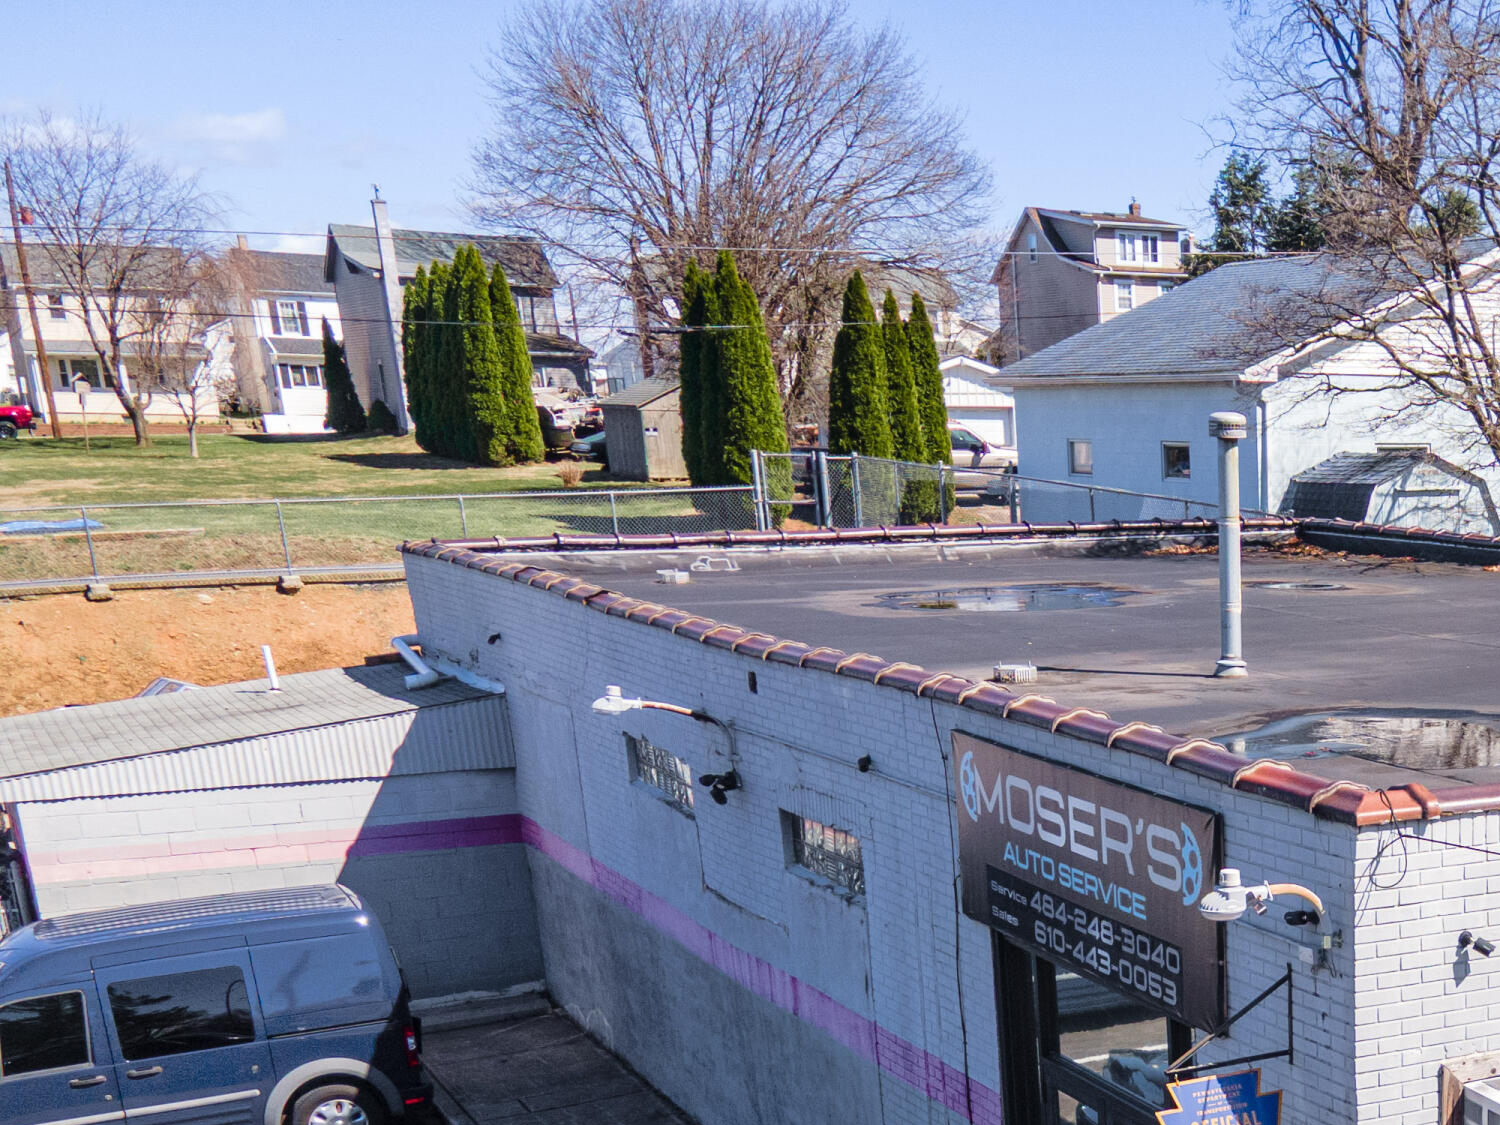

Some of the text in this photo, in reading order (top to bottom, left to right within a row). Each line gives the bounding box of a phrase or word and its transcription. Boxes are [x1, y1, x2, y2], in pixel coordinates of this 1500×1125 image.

[973, 763, 1182, 893] MOSER'S
[990, 879, 1180, 975] Service 484-248-3040
[1003, 842, 1147, 921] AUTO SERVICE
[992, 905, 1177, 1006] Sales 610-443-0053
